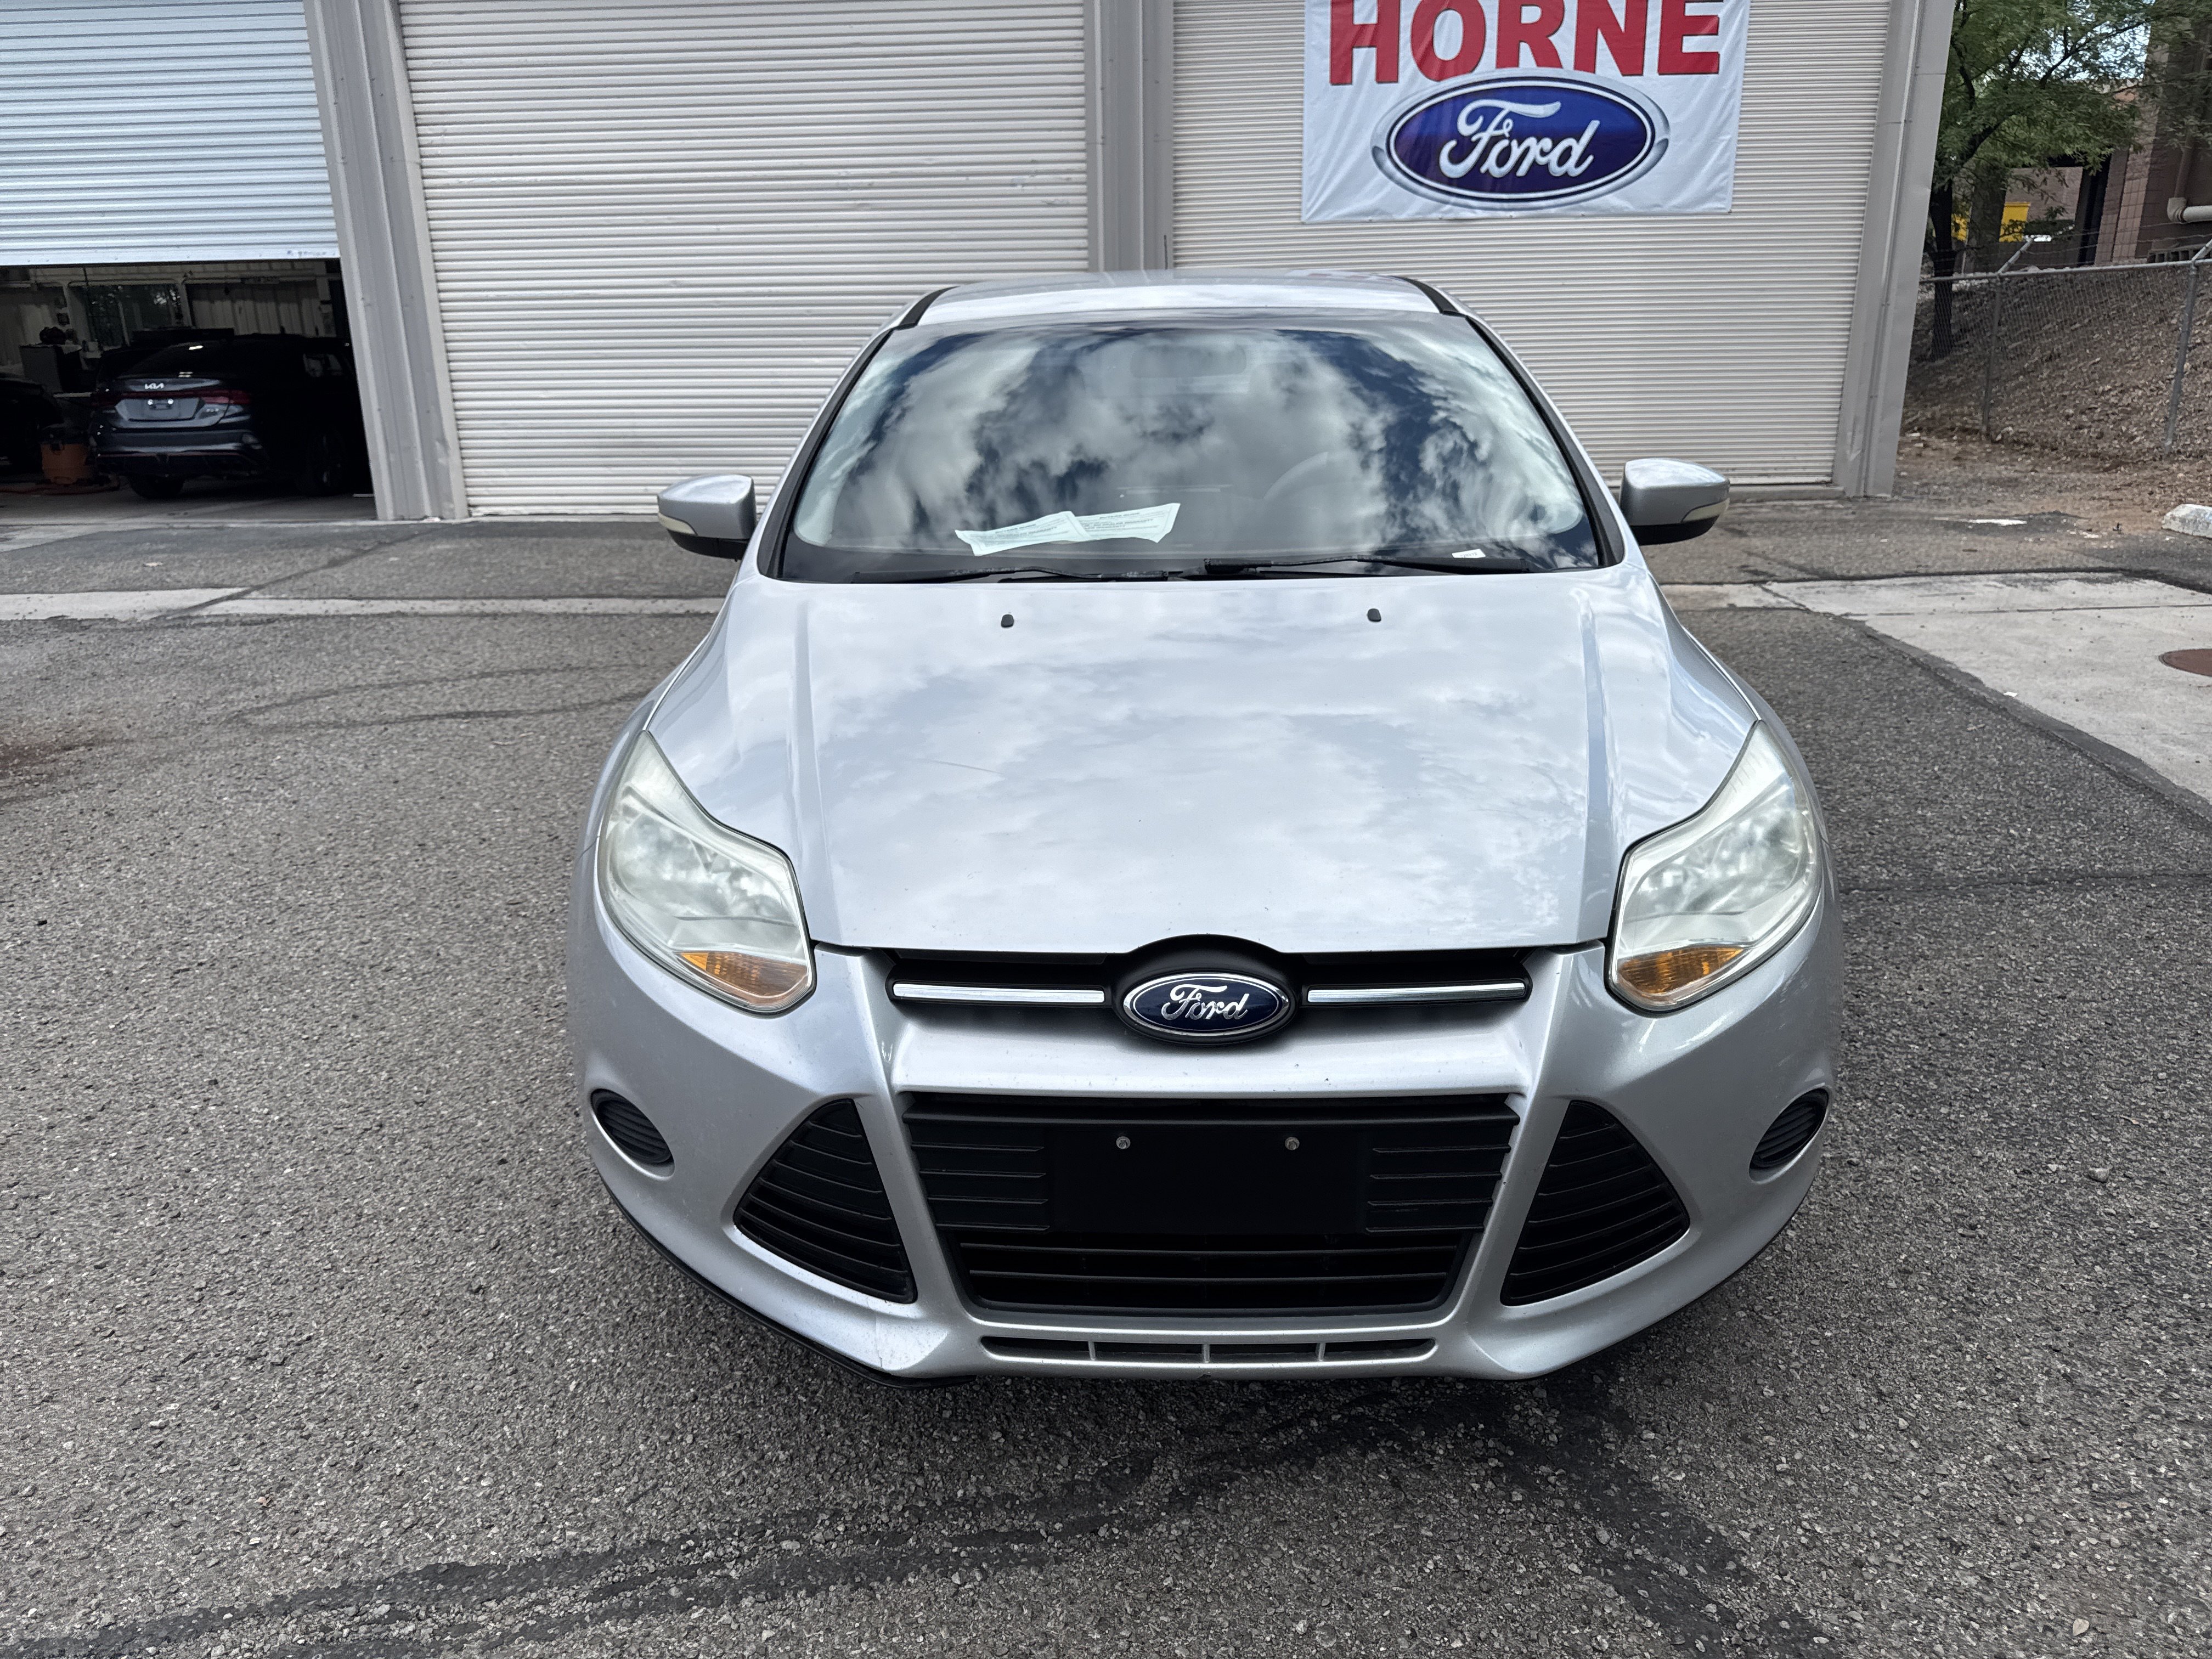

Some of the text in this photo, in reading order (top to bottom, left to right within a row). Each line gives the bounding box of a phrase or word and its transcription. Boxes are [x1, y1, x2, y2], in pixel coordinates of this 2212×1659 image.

[1330, 0, 1723, 85] HORNE
[1439, 99, 1600, 178] Ford
[1161, 984, 1250, 1020] Ford
